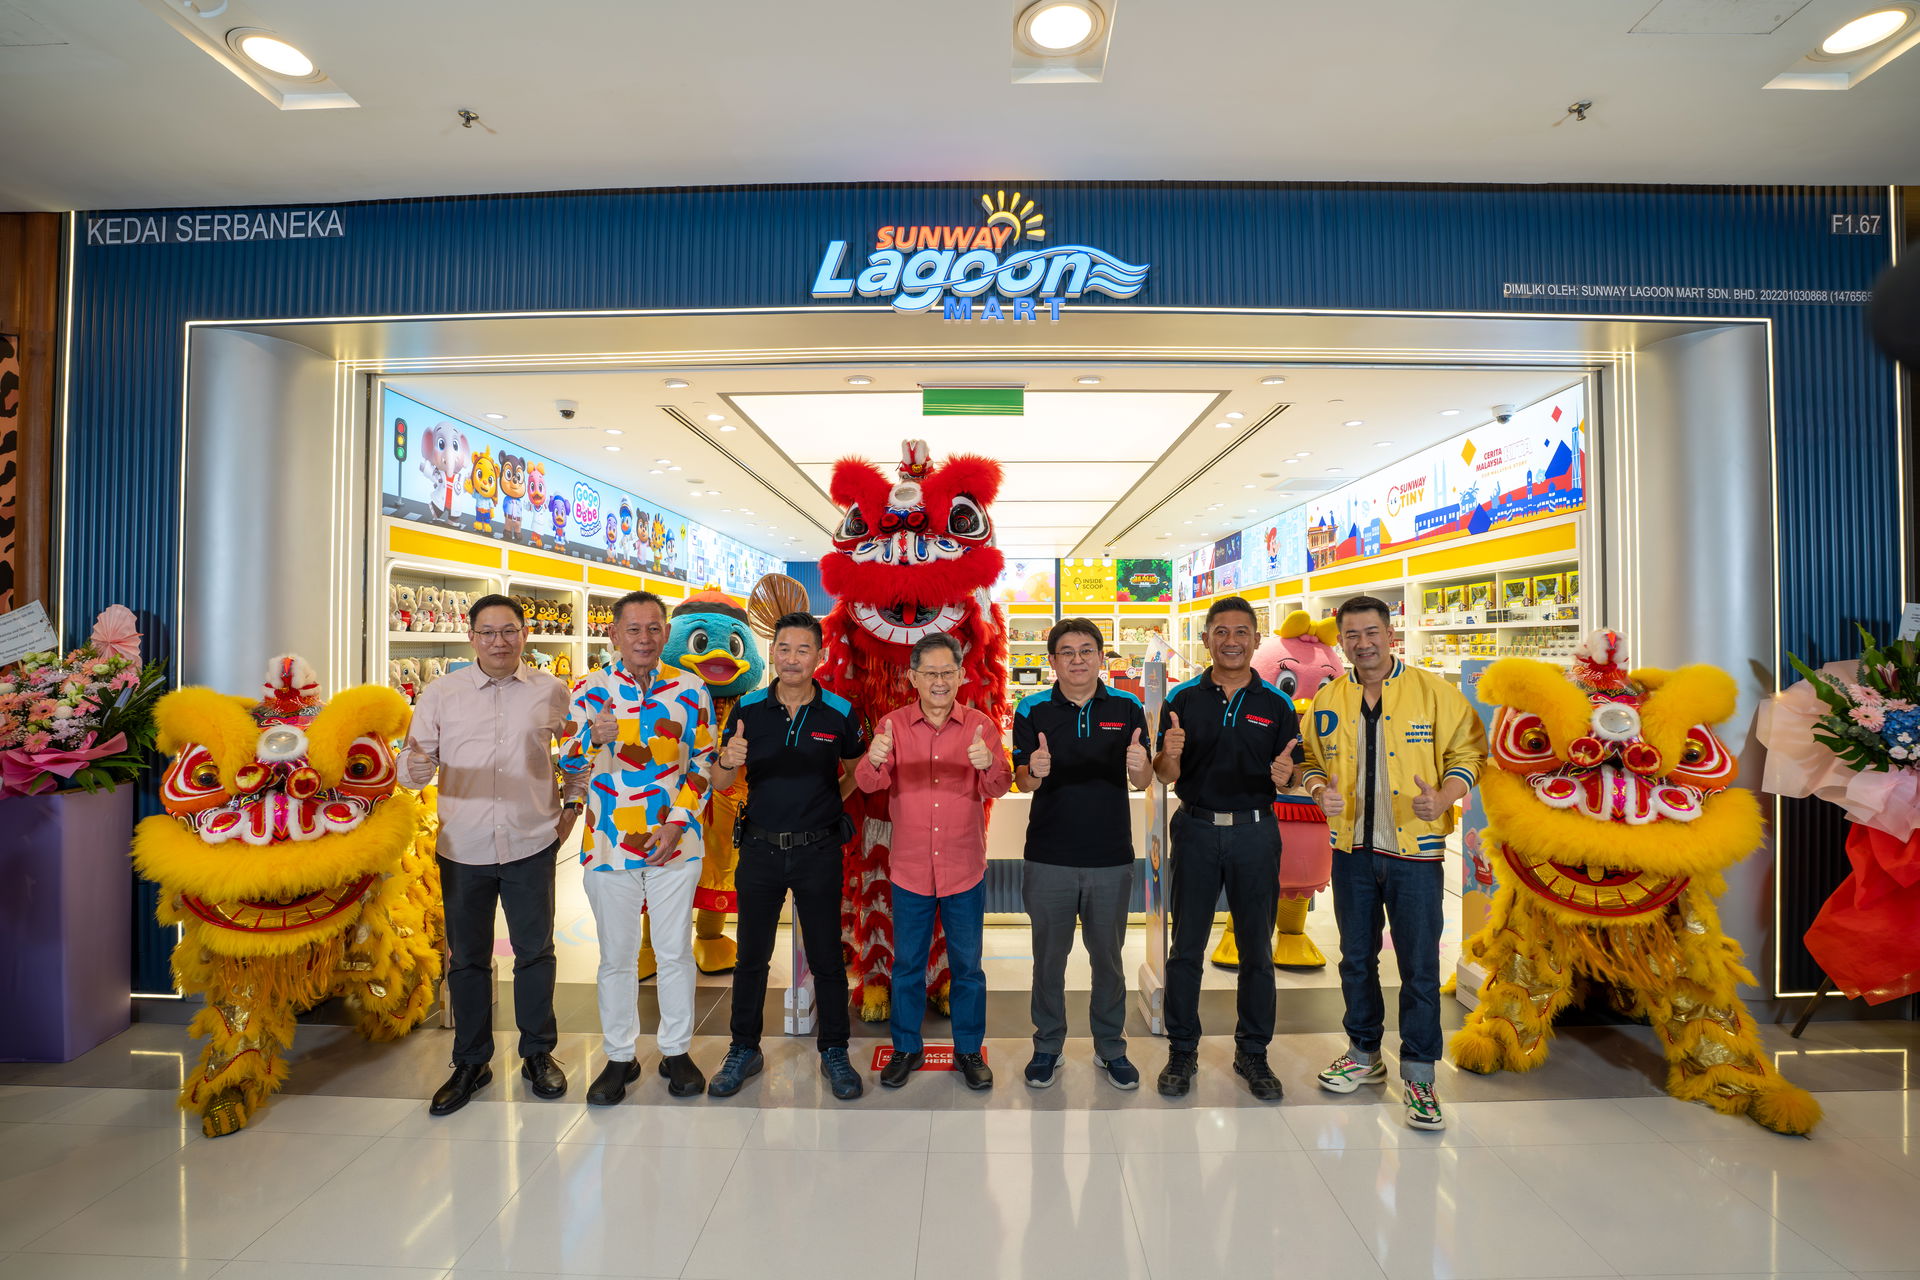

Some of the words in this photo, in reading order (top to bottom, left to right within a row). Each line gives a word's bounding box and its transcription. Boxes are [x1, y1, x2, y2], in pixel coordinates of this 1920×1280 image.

[88, 216, 167, 245] KEDAI
[176, 210, 344, 242] SERBANEKA
[1832, 215, 1881, 234] F1.67
[875, 225, 1014, 250] SUNWAY
[811, 240, 1098, 314] Lagoon
[1504, 283, 1545, 295] DIMILIKI
[1547, 284, 1579, 296] OLEH:
[1581, 285, 1627, 297] SUNWAY
[1630, 286, 1674, 298] LAGOON
[1676, 287, 1705, 298] MART
[1707, 288, 1731, 300] SDN.
[1734, 289, 1758, 300] BHD.
[1760, 290, 1828, 301] 202201030868
[943, 297, 1066, 322] MART
[1400, 475, 1427, 494] SUNWAY
[576, 487, 598, 507] Gogo
[1400, 487, 1424, 508] TINY
[1314, 710, 1338, 736] D
